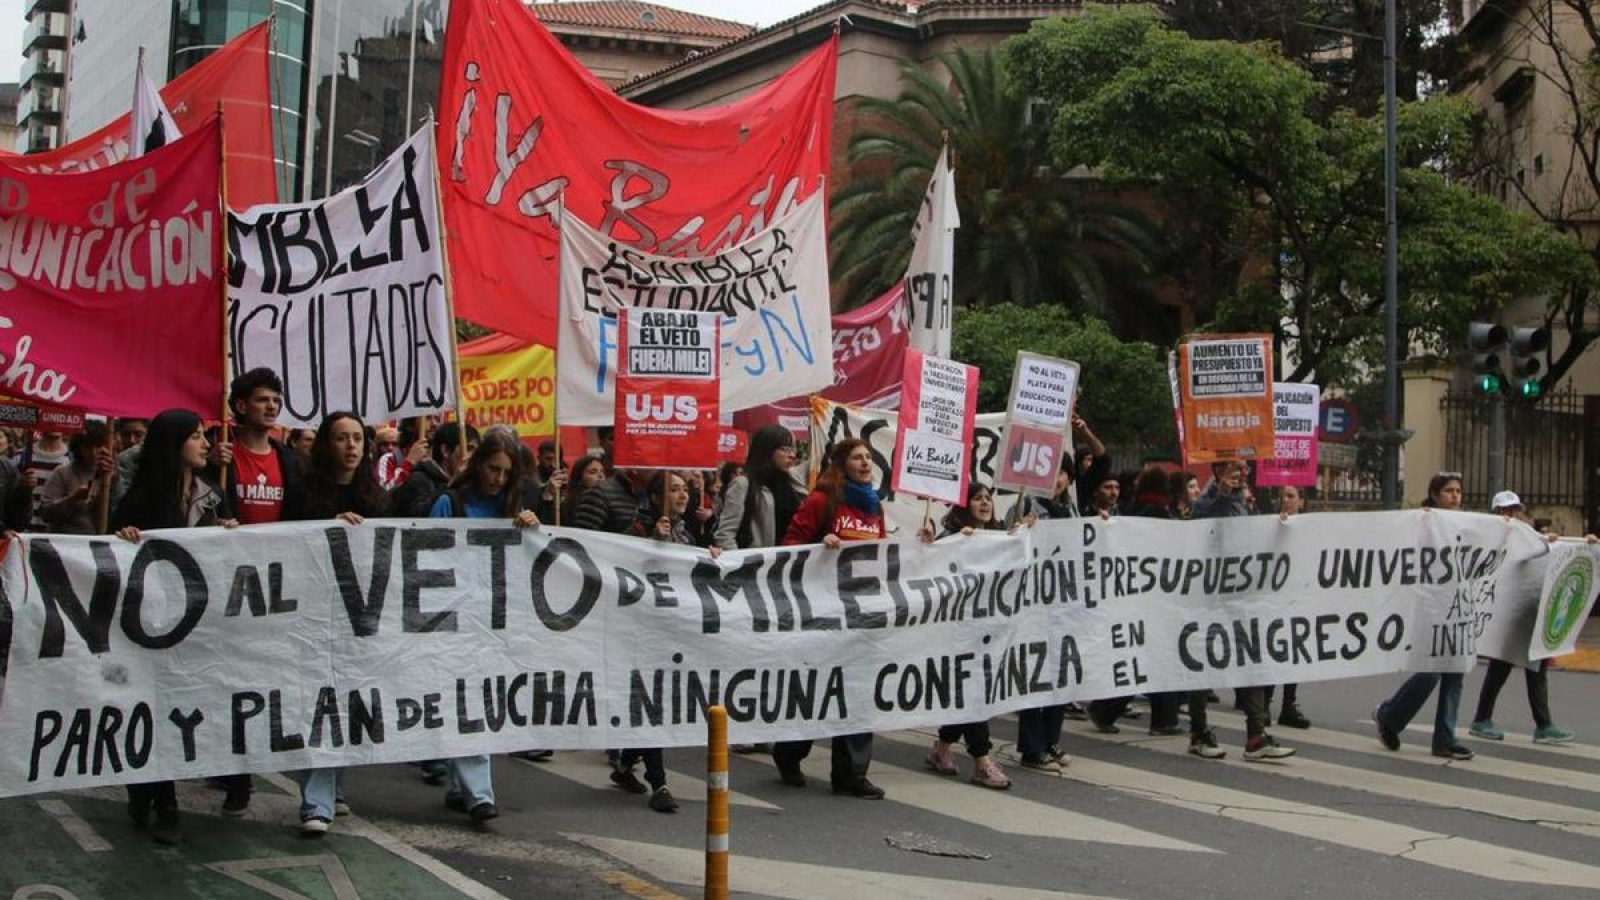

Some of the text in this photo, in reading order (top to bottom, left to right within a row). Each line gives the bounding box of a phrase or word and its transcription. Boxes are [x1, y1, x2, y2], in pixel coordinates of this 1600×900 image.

[89, 168, 156, 228] de
[600, 228, 793, 285] ASAMBLEA
[641, 312, 698, 328] ABAJO
[640, 328, 701, 346] EL VETO
[1193, 343, 1260, 358] AUMENTO DE
[630, 349, 710, 374] FUERA MILEI
[1193, 357, 1252, 372] PRESUPUESTO
[626, 393, 699, 422] UJS
[1195, 412, 1260, 431] Naranja
[1327, 407, 1344, 432] E
[1012, 440, 1053, 477] JIS
[1099, 552, 1290, 601] PRESUPUESTO
[30, 538, 209, 659] NO
[224, 561, 298, 618] AL
[324, 527, 602, 637] VETO
[614, 566, 679, 607] DE
[1111, 619, 1145, 649] EN
[1113, 657, 1149, 687] EL
[28, 701, 154, 782] PARO
[168, 707, 204, 762] Y
[231, 686, 386, 755] PLAN
[396, 692, 444, 731] DE
[874, 634, 1083, 712] CONFIANZA
